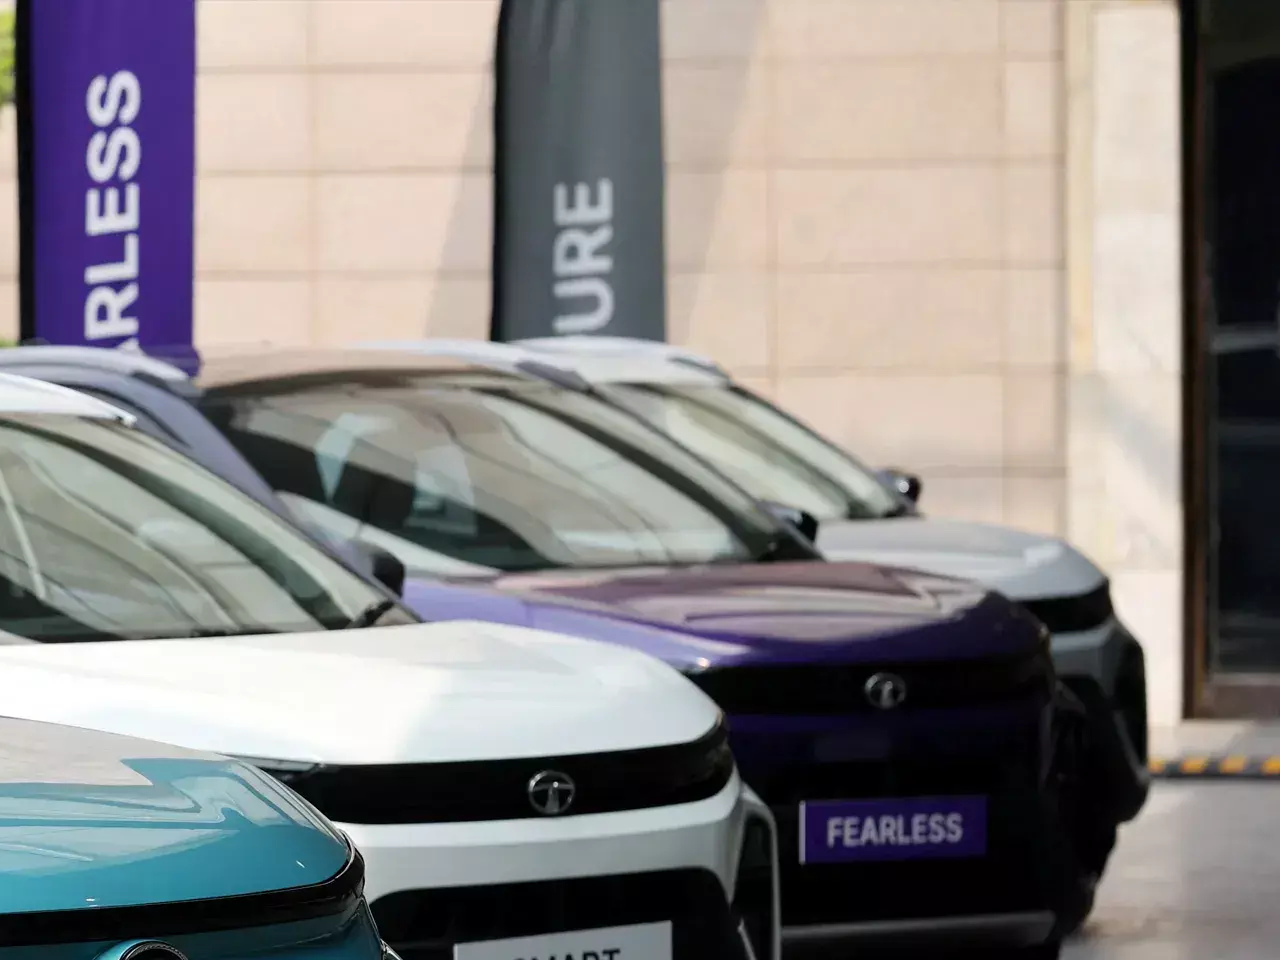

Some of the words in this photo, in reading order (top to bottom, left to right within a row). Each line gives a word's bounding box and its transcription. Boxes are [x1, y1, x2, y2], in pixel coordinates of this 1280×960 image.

[84, 70, 141, 351] RLESS
[553, 177, 614, 333] URE
[827, 812, 963, 848] FEARLESS
